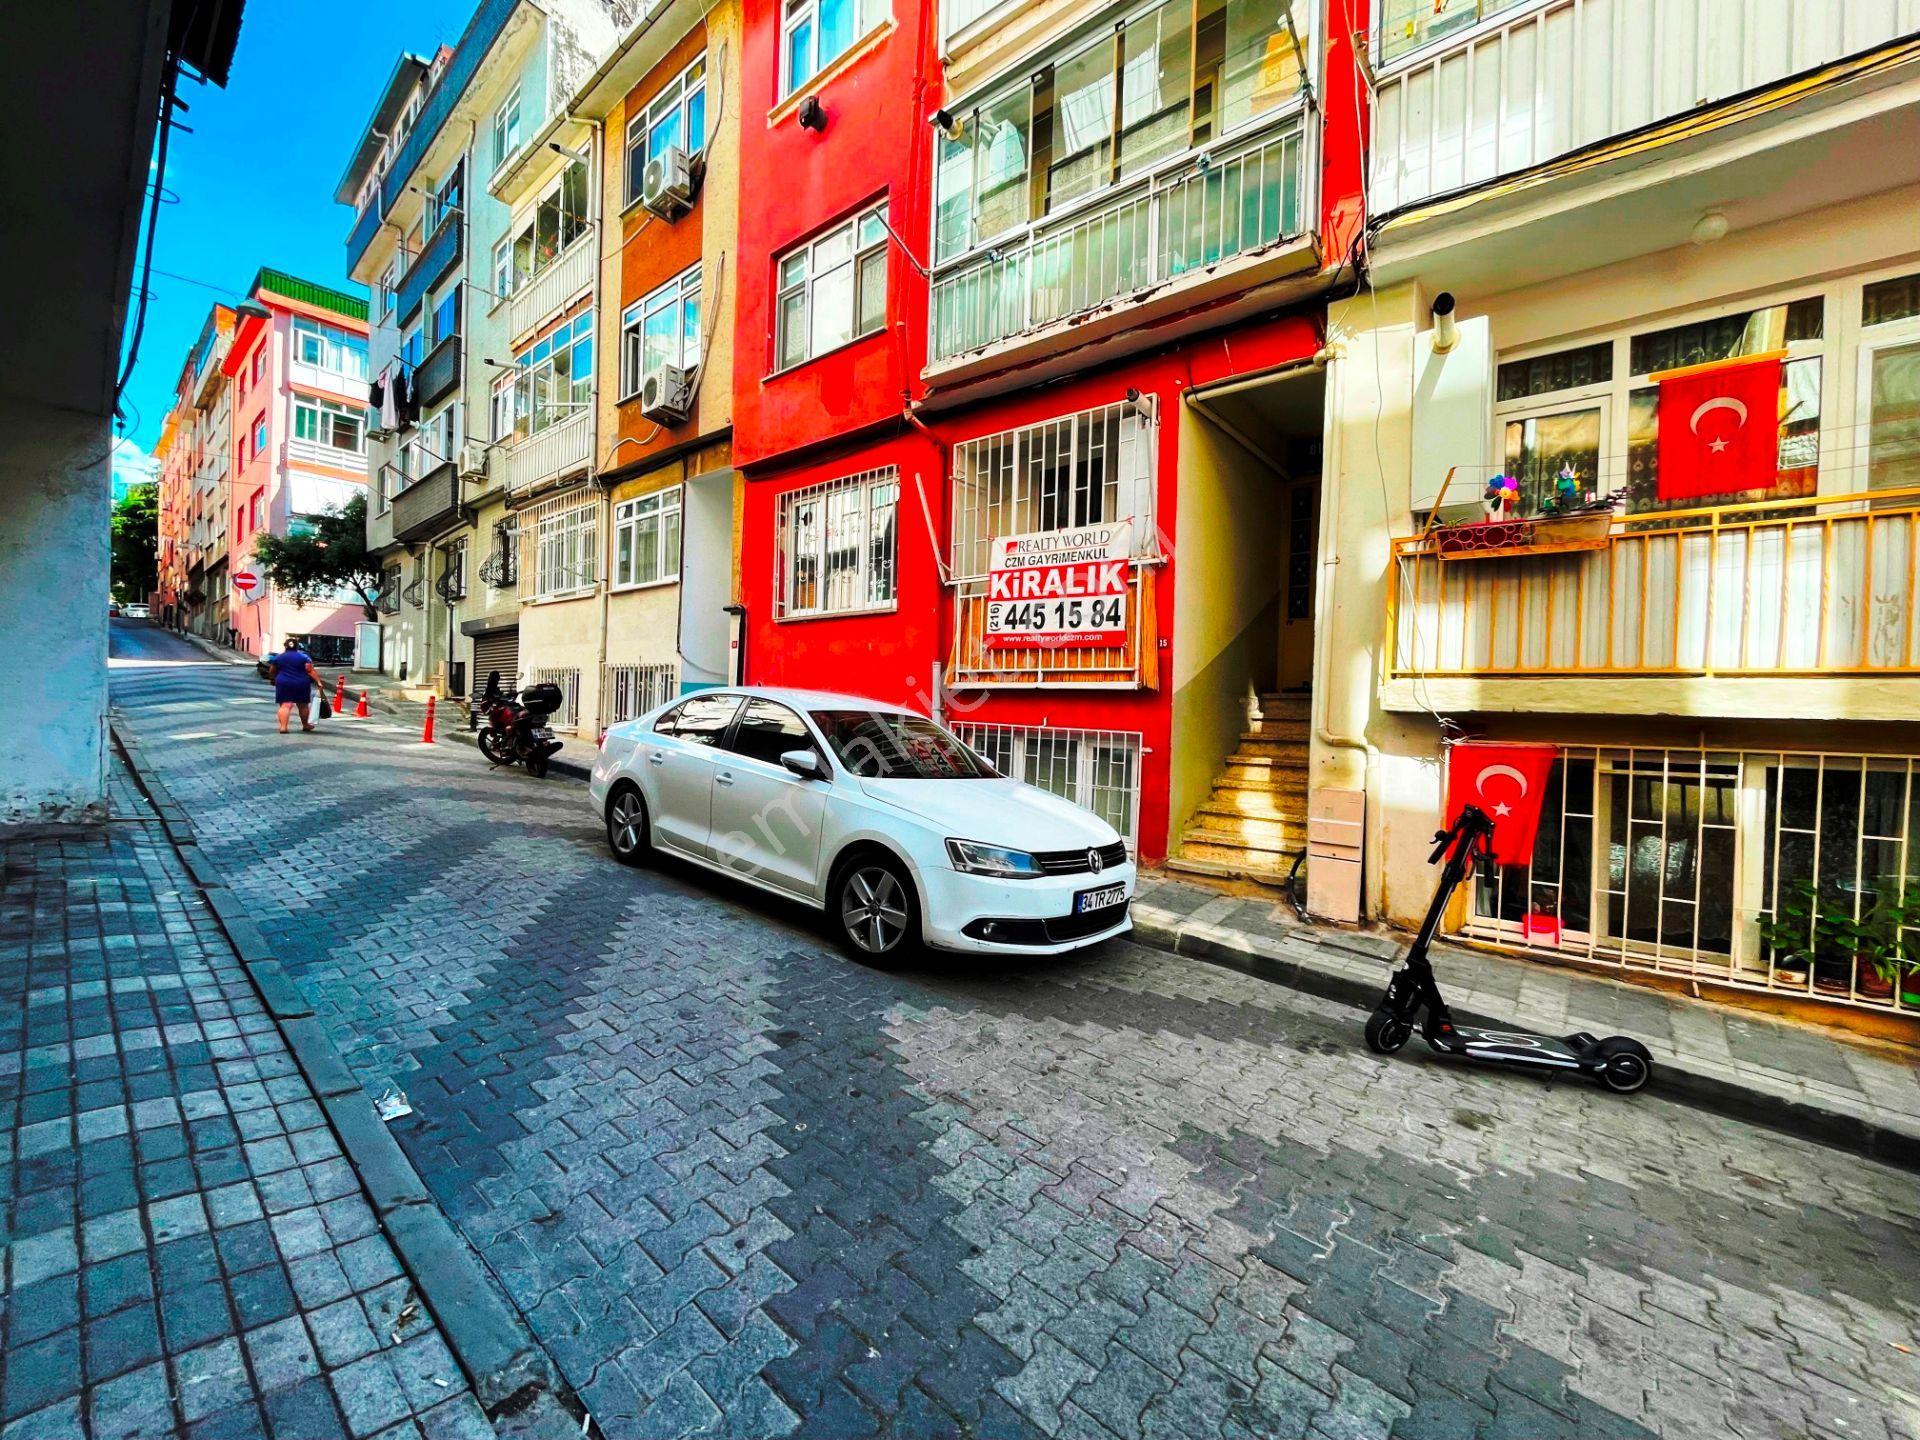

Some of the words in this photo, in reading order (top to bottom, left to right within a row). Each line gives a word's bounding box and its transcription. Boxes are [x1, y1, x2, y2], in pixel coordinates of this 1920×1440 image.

[1018, 537, 1060, 552] REALTY
[1062, 530, 1111, 548] WORLD
[1004, 556, 1026, 569] CZM
[989, 603, 1003, 632] (216)
[1004, 603, 1046, 630] 445
[1054, 600, 1083, 629] 15
[1090, 598, 1121, 629] 84
[1002, 633, 1103, 643] www.realtyworldczm.com
[1082, 892, 1093, 911] 34
[1094, 890, 1106, 908] TR
[1106, 887, 1125, 905] 2775
